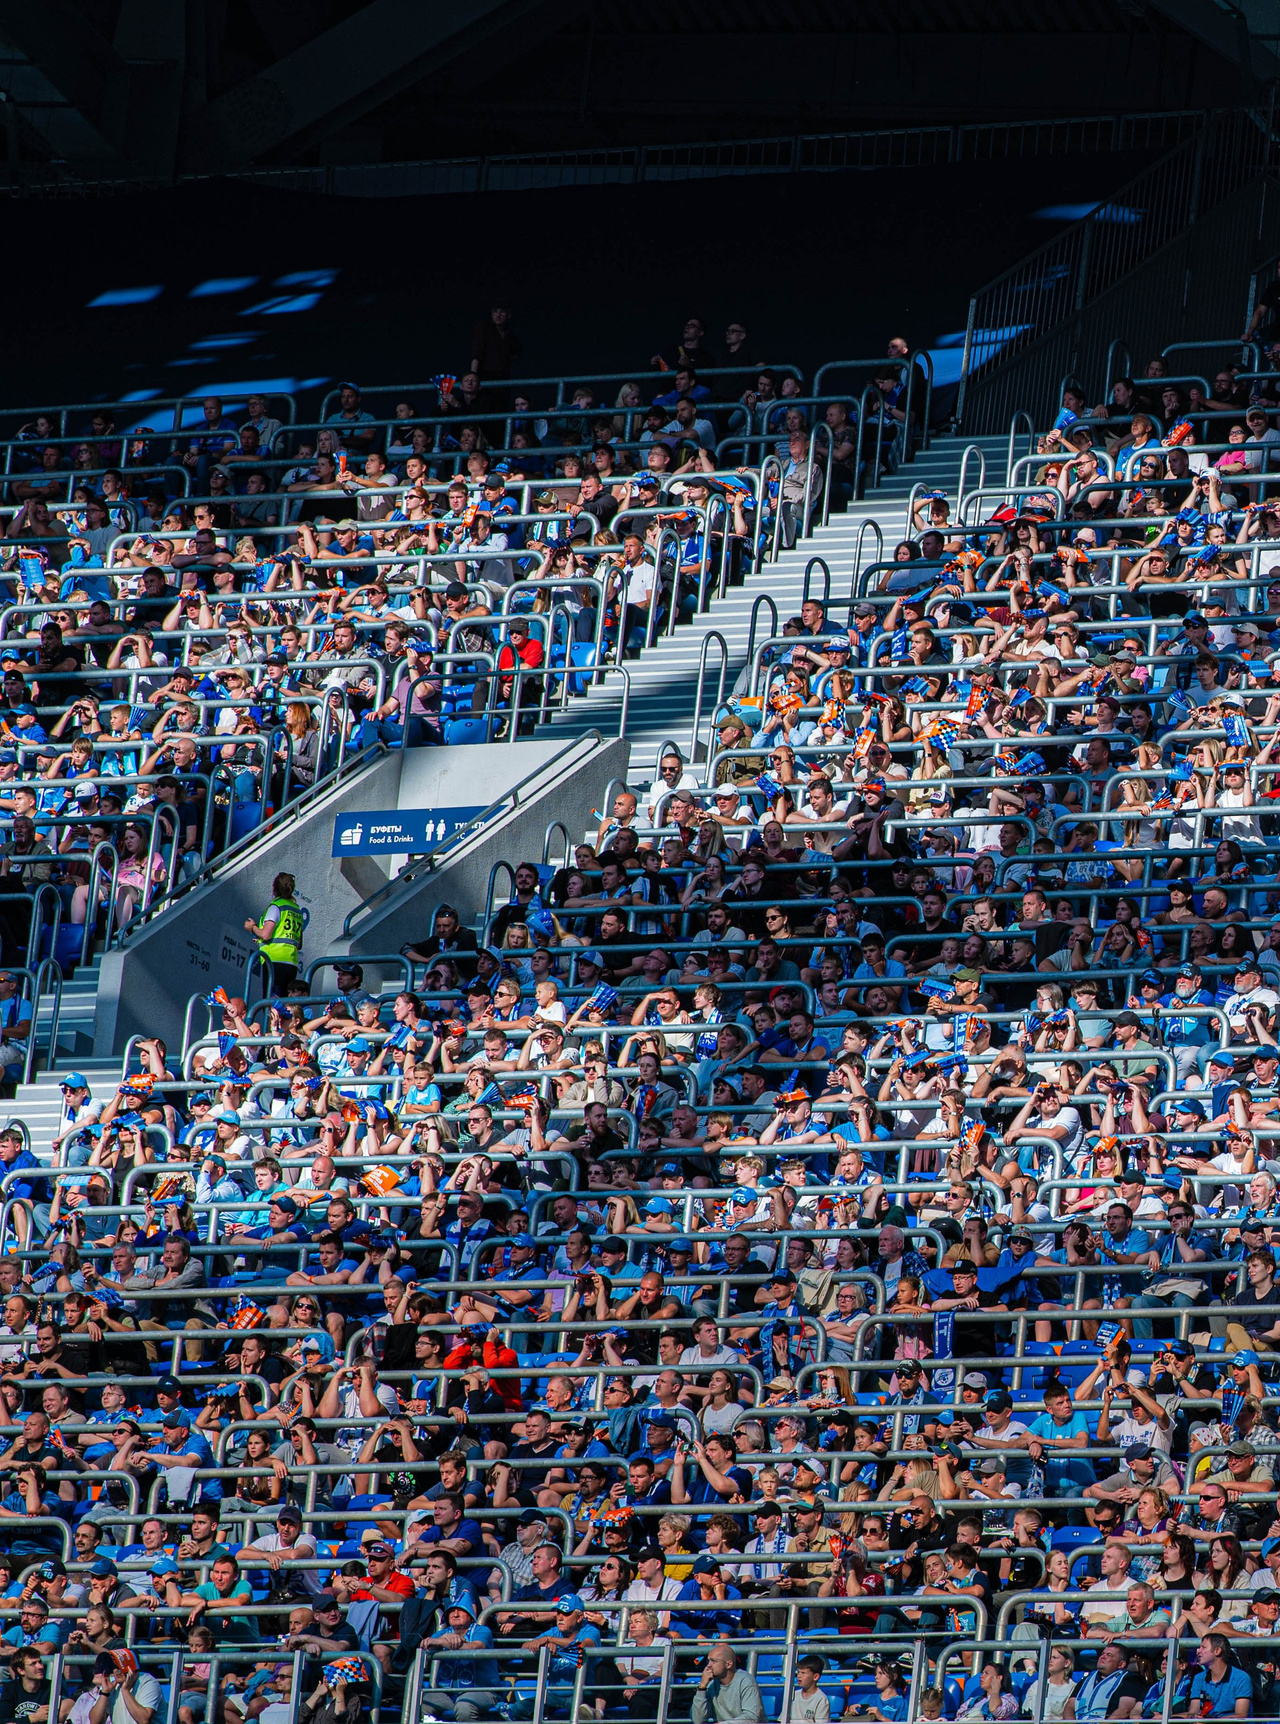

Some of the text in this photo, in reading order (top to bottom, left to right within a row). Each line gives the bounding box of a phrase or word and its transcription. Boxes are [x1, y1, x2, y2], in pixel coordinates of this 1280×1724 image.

[370, 825, 402, 834] БУФЕТЫ
[394, 834, 414, 843] Drinks
[190, 954, 210, 972] 31-60
[222, 946, 246, 968] 01-17
